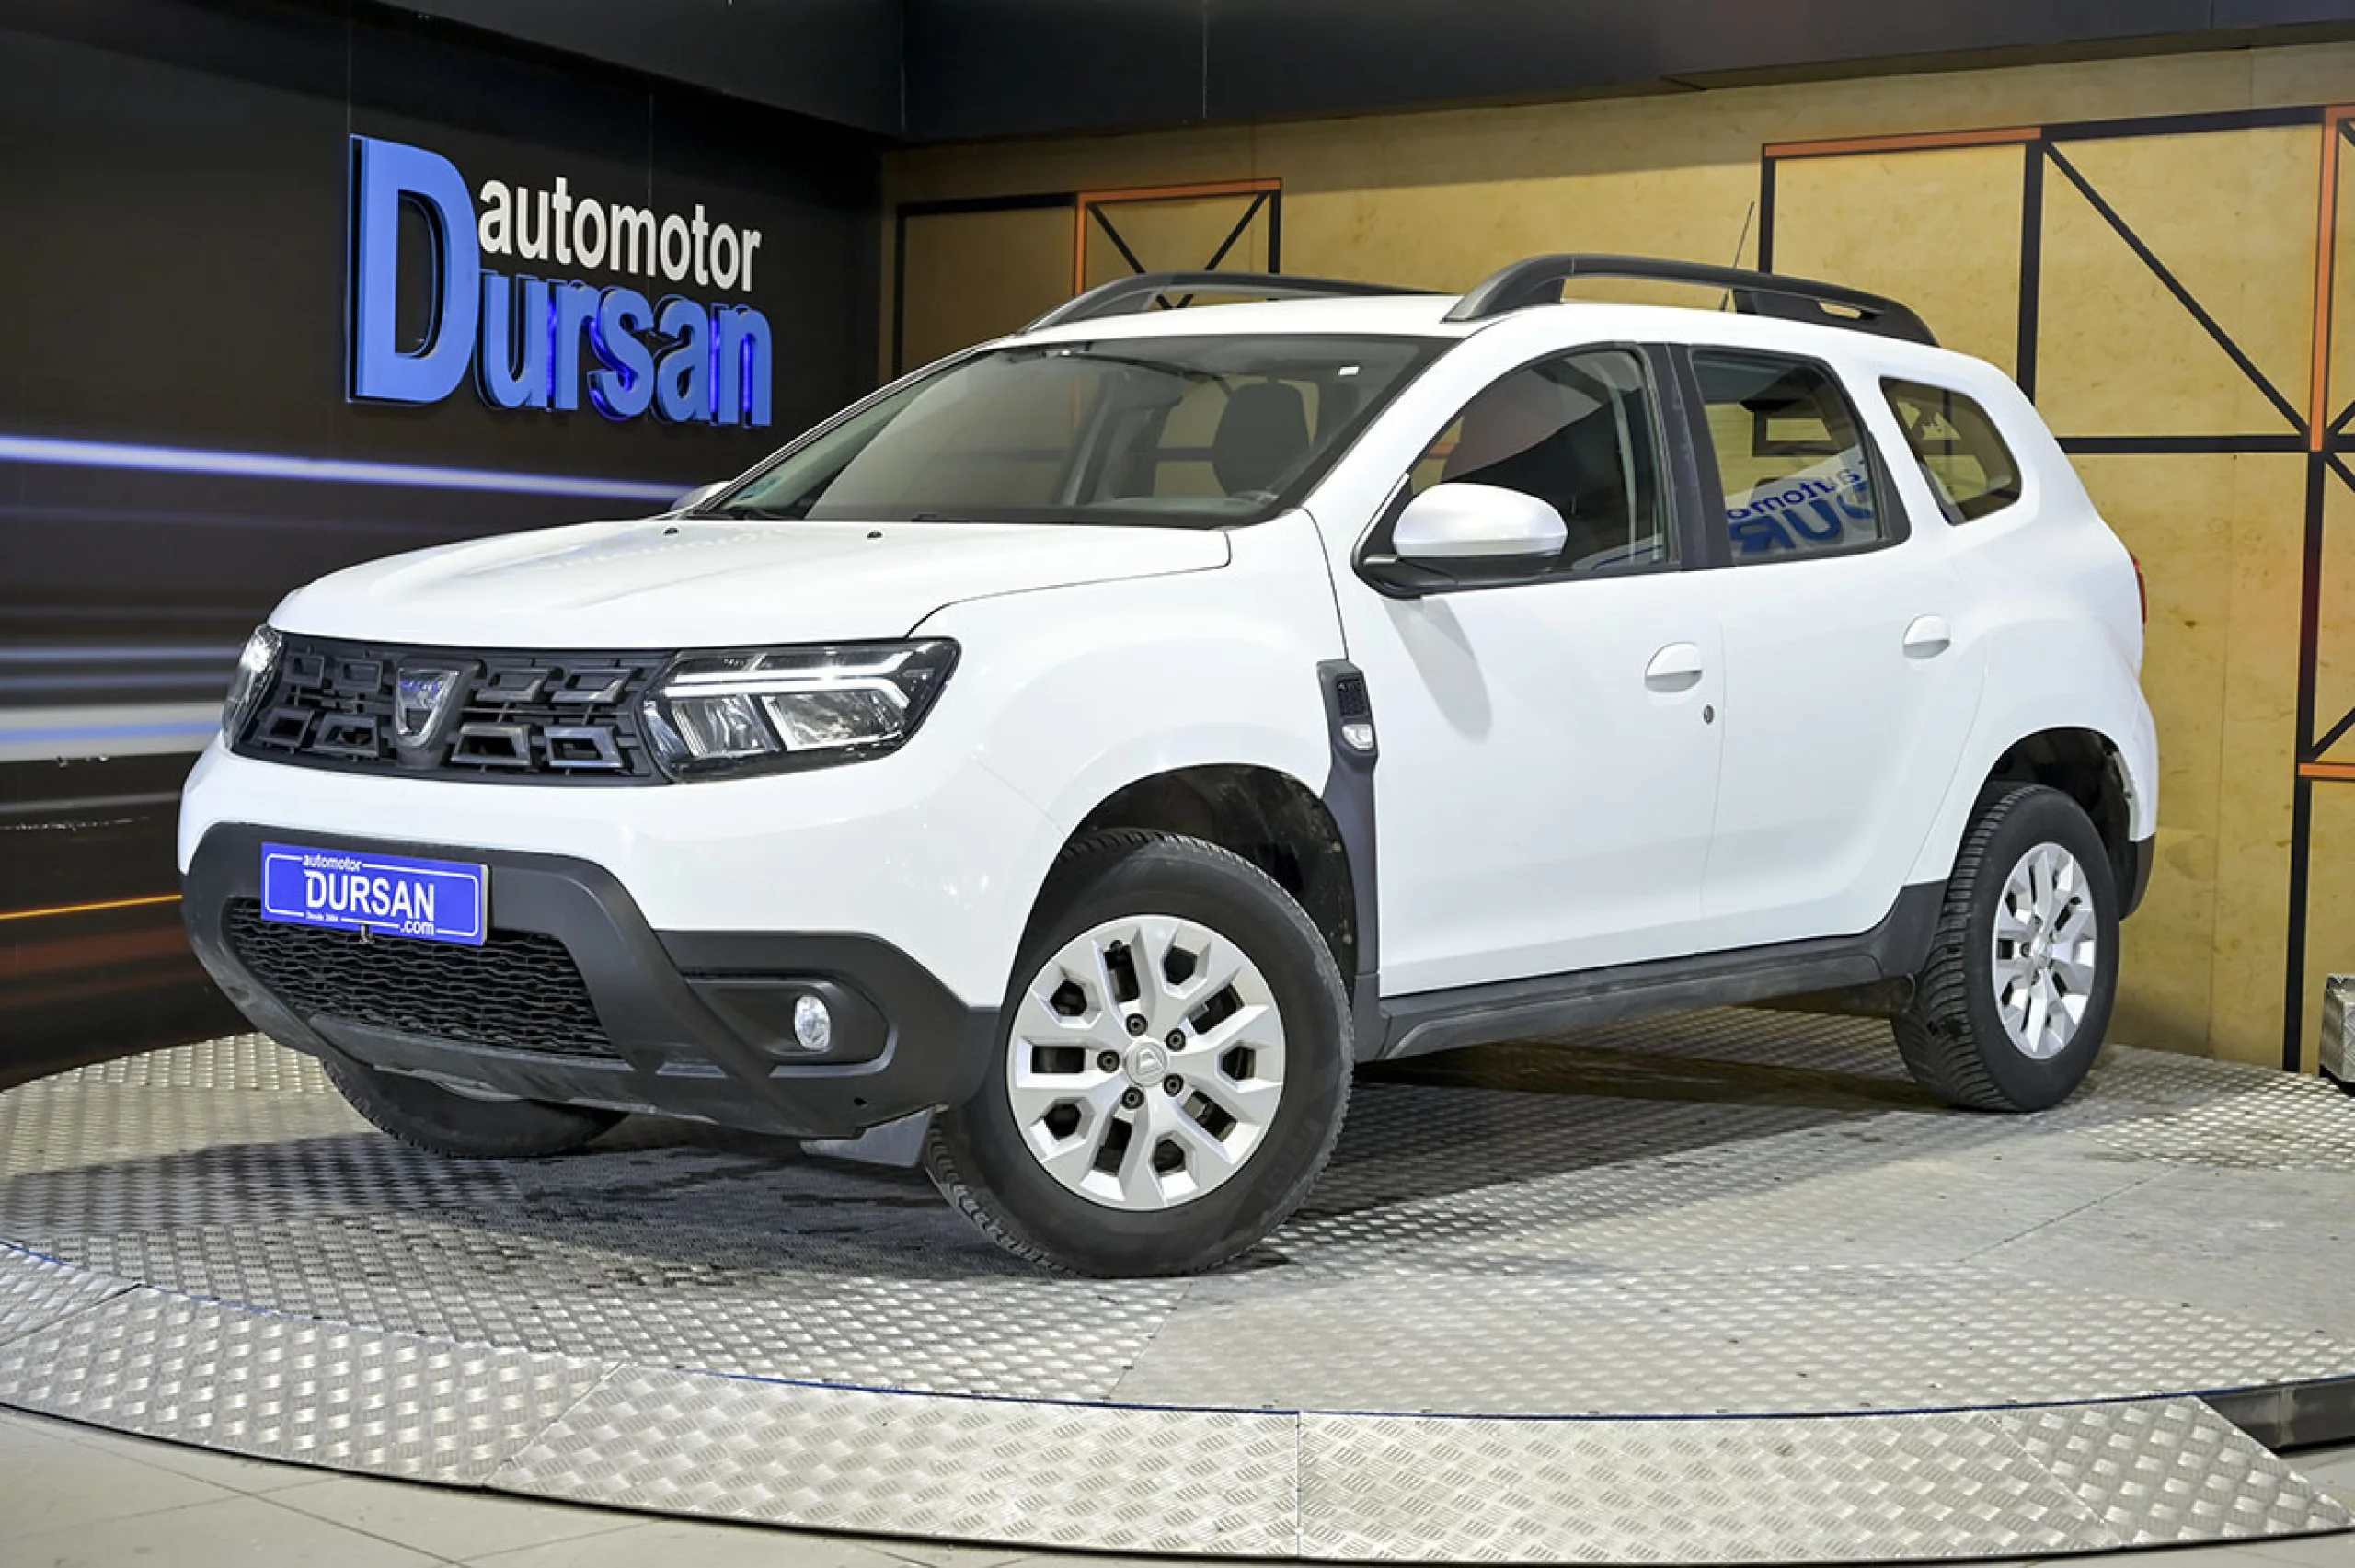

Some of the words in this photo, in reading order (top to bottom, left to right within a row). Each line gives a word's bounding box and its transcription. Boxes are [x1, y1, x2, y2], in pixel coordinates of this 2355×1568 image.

[478, 177, 763, 292] automotor
[348, 133, 773, 428] Dursan
[303, 853, 362, 872] automotor
[304, 869, 435, 921] DURSAN
[399, 919, 435, 936] .com
